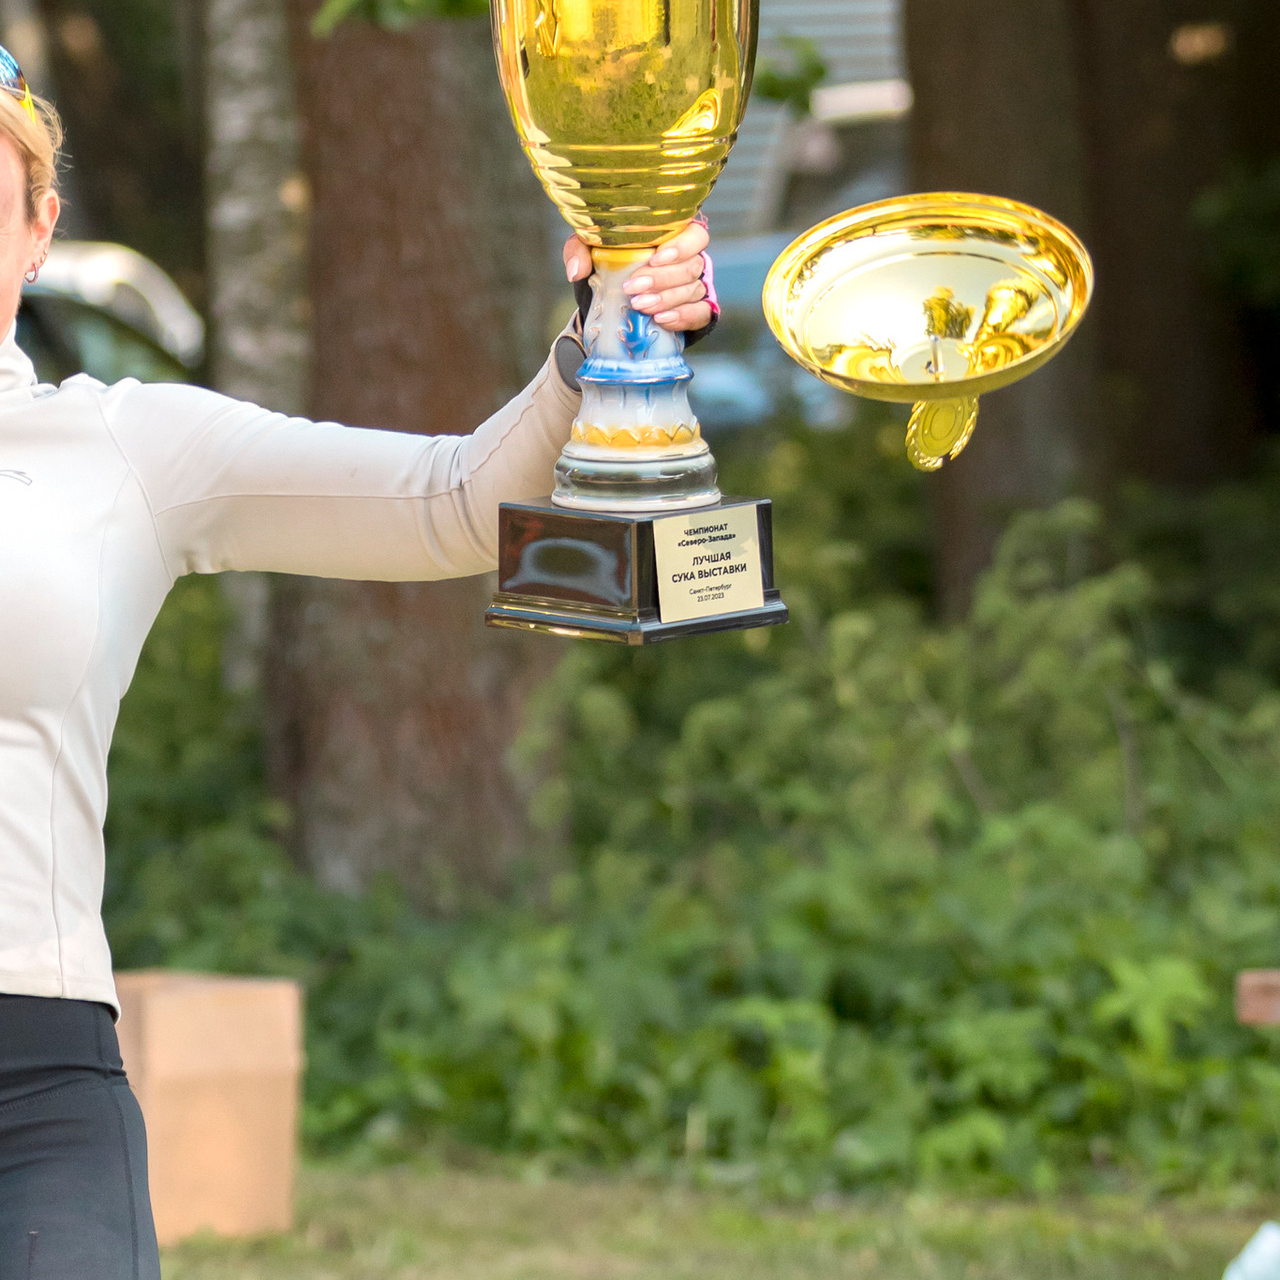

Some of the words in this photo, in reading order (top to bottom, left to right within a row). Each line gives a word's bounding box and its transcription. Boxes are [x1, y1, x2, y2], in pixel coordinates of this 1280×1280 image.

[684, 523, 728, 536] ЧЕМПИОНАТ
[678, 533, 736, 547] «Северо-Запада»
[692, 551, 731, 566] ЛУЧШАЯ
[672, 571, 696, 583] СУКА
[698, 563, 747, 579] ВЫСТАВКИ
